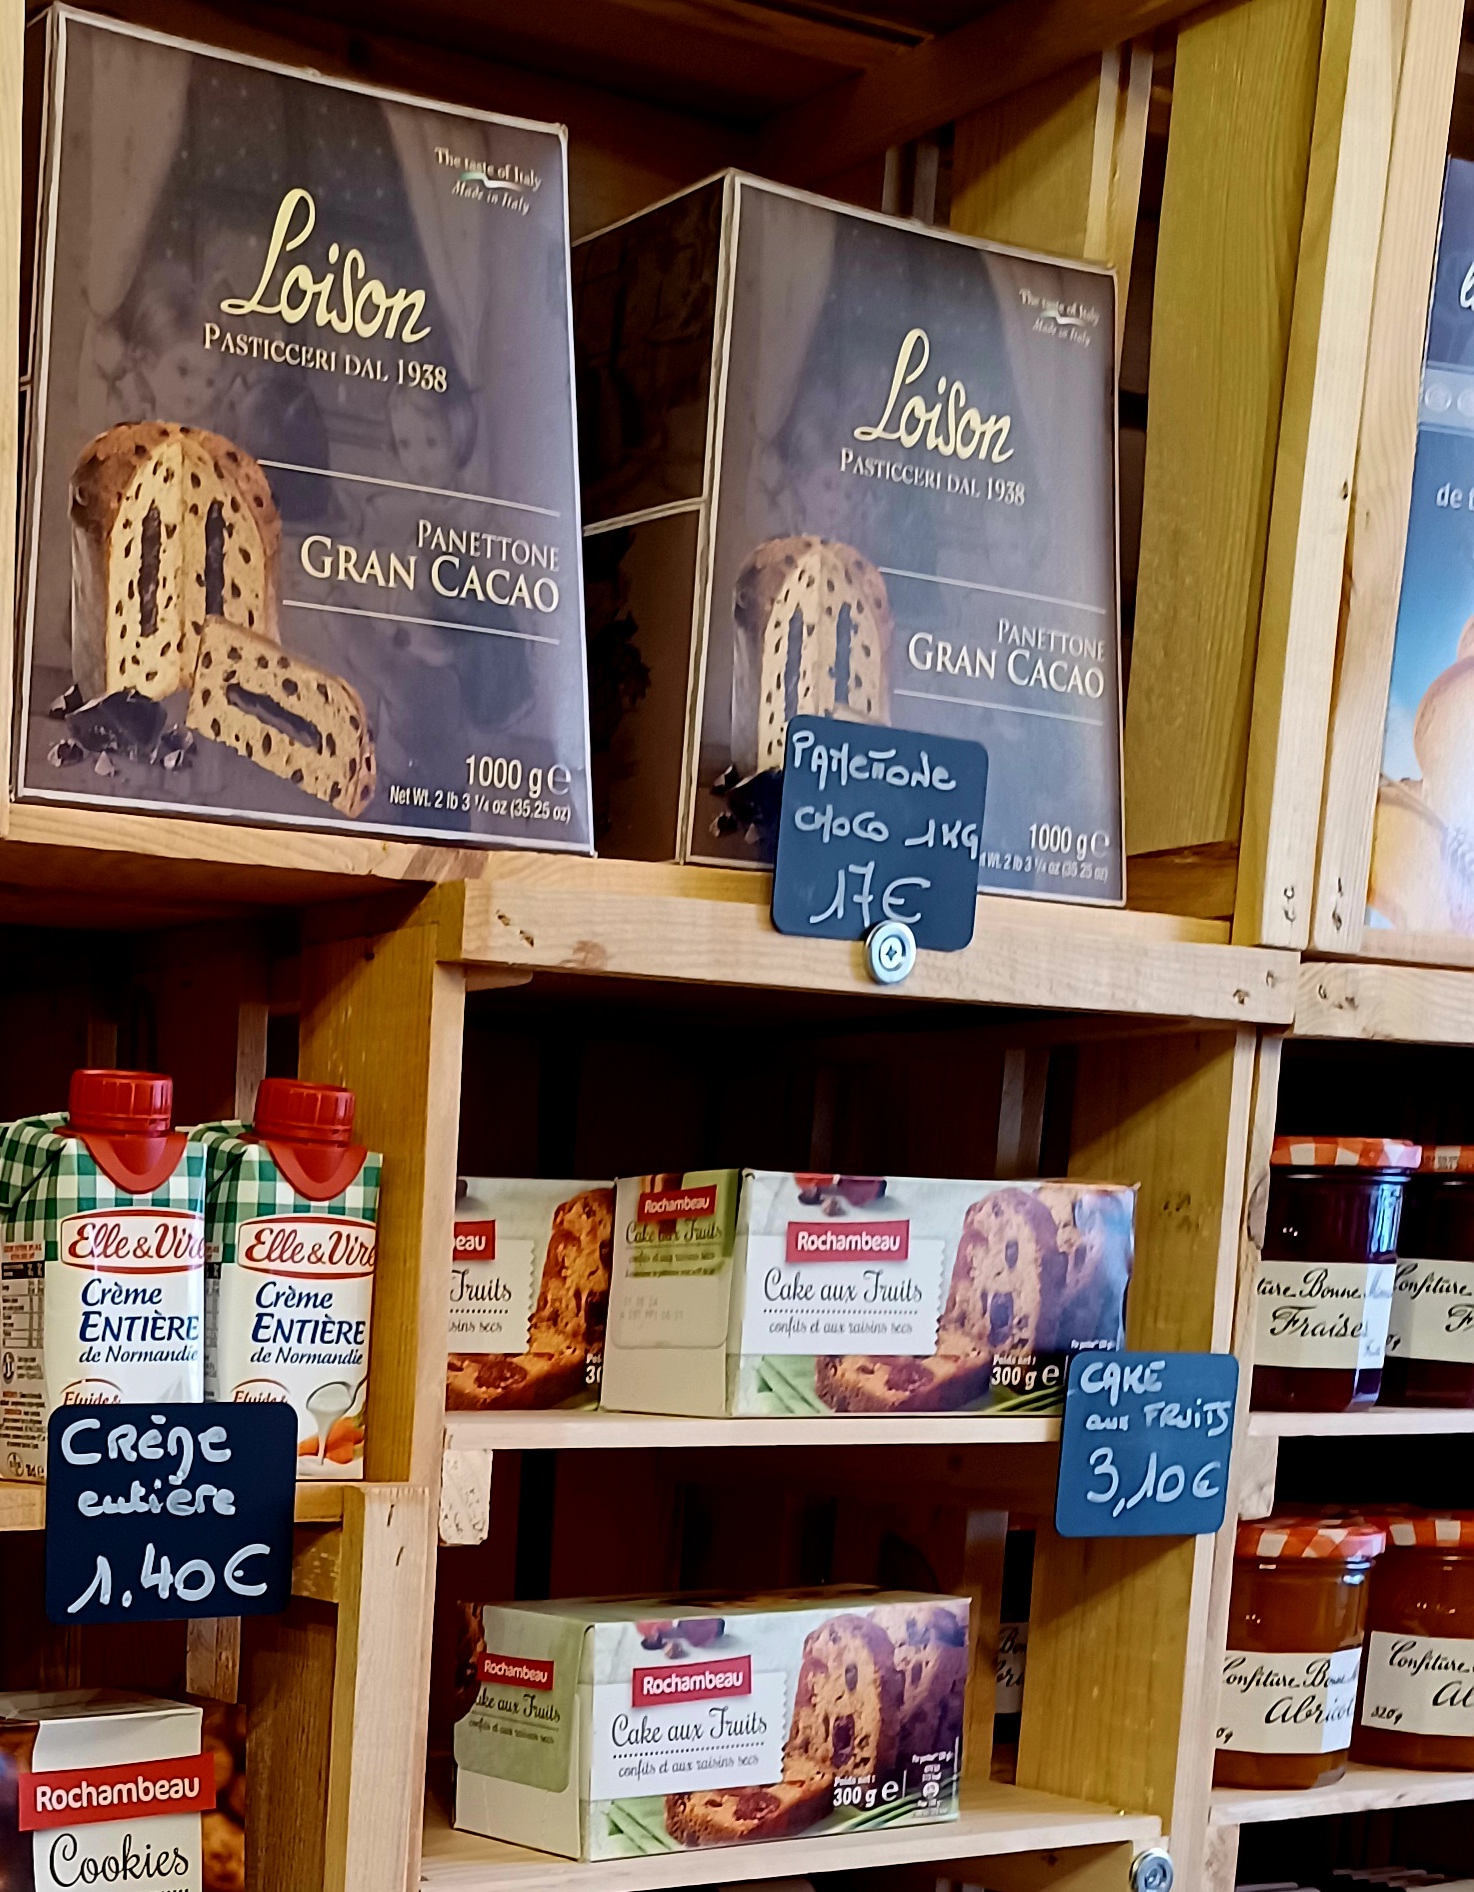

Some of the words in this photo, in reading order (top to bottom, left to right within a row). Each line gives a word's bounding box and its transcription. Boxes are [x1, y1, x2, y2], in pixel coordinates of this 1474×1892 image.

[433, 146, 461, 169] The
[497, 162, 512, 180] of
[513, 164, 542, 193] Italy
[451, 180, 484, 201] Made
[501, 190, 530, 216] Italy
[219, 187, 432, 344] Loison
[203, 322, 337, 372] PASTICCERI
[344, 354, 388, 382] DAL
[397, 358, 448, 394] 1938
[853, 326, 1015, 464] Loison
[839, 446, 941, 490] PASTICCERI
[946, 474, 981, 499] DAL
[986, 476, 1026, 507] 1938
[1435, 481, 1463, 509] de
[417, 518, 560, 573] PANETTONE
[300, 534, 418, 592] GRAN
[431, 554, 560, 613] CACAO
[997, 617, 1105, 662] PANETTONE
[908, 630, 996, 680] GRAN
[1007, 648, 1104, 699] CACAO
[465, 754, 523, 791] 1000
[389, 784, 411, 806] Net
[433, 789, 444, 810] 2
[461, 793, 471, 813] 3
[492, 800, 508, 817] oz
[510, 797, 550, 820] (35.25
[1029, 822, 1072, 853] 1000
[644, 1196, 710, 1214] Rochambeau
[796, 1229, 901, 1252] Rochambeau
[81, 1277, 163, 1307] Crème
[255, 1280, 334, 1310] Crème
[763, 1266, 814, 1302] Cake
[820, 1281, 858, 1304] aux
[863, 1268, 923, 1304] Fruits
[78, 1309, 200, 1343] ENTIÈRE
[251, 1312, 366, 1346] ENTIÈRE
[78, 1345, 102, 1364] de
[103, 1344, 200, 1364] Normandie
[250, 1346, 273, 1365] de
[274, 1346, 364, 1366] Normandie
[990, 1366, 1022, 1387] 300
[1080, 1359, 1166, 1407] CAKE
[483, 1659, 548, 1683] Rochambeau
[642, 1669, 744, 1696] Rochambeau
[611, 1712, 663, 1748] Cake
[667, 1721, 704, 1742] aux
[708, 1705, 768, 1740] Fruits
[35, 1774, 201, 1812] Rochambeau
[832, 1785, 863, 1807] 300
[48, 1832, 190, 1888] Cookies
